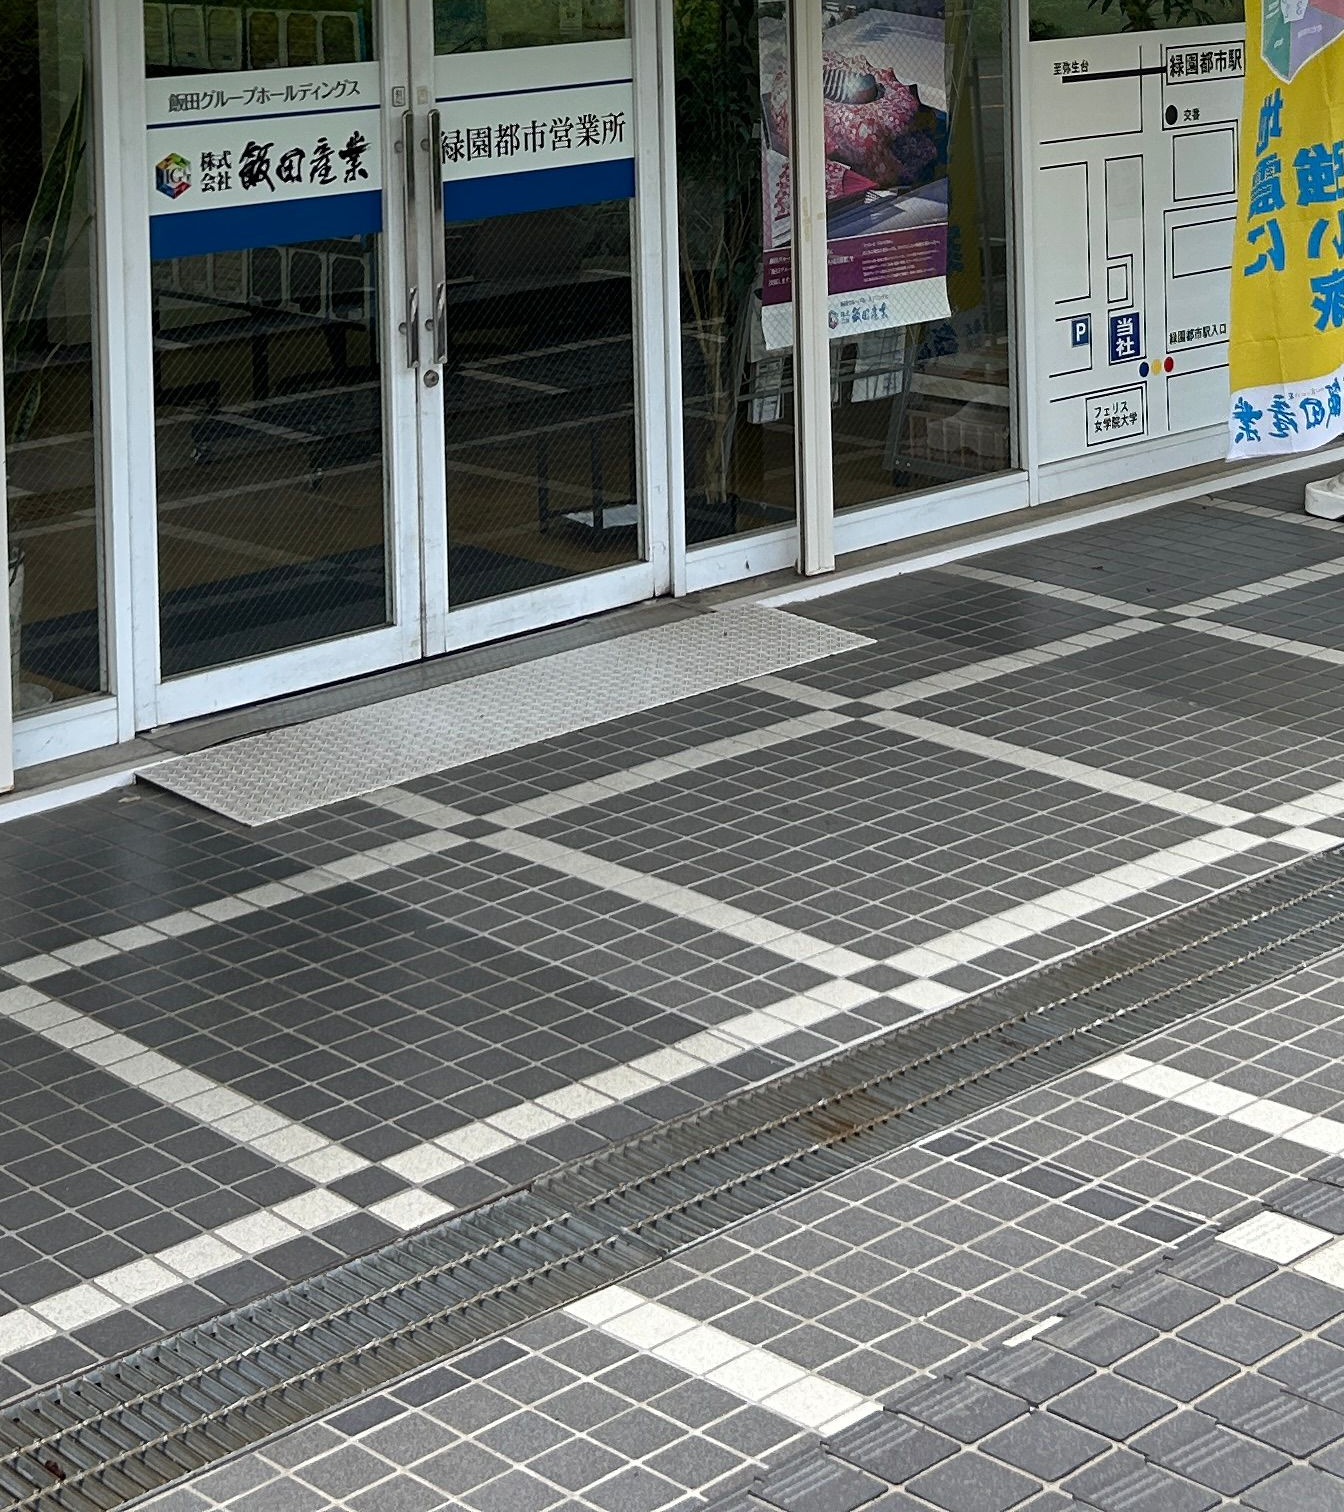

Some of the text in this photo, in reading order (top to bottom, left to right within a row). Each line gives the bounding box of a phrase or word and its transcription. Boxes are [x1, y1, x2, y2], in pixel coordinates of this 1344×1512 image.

[1169, 48, 1243, 78] 緑園都市駅
[167, 78, 361, 114] 飯田グループホールディングス
[440, 110, 627, 166] 緑園都市営業所
[200, 150, 232, 173] 株式
[238, 129, 373, 193] 飯田産業
[200, 171, 233, 193] 会社
[1075, 322, 1087, 342] P
[1115, 316, 1136, 358] 当社
[1094, 400, 1129, 419] フェリス
[1094, 412, 1138, 433] 女学院大学
